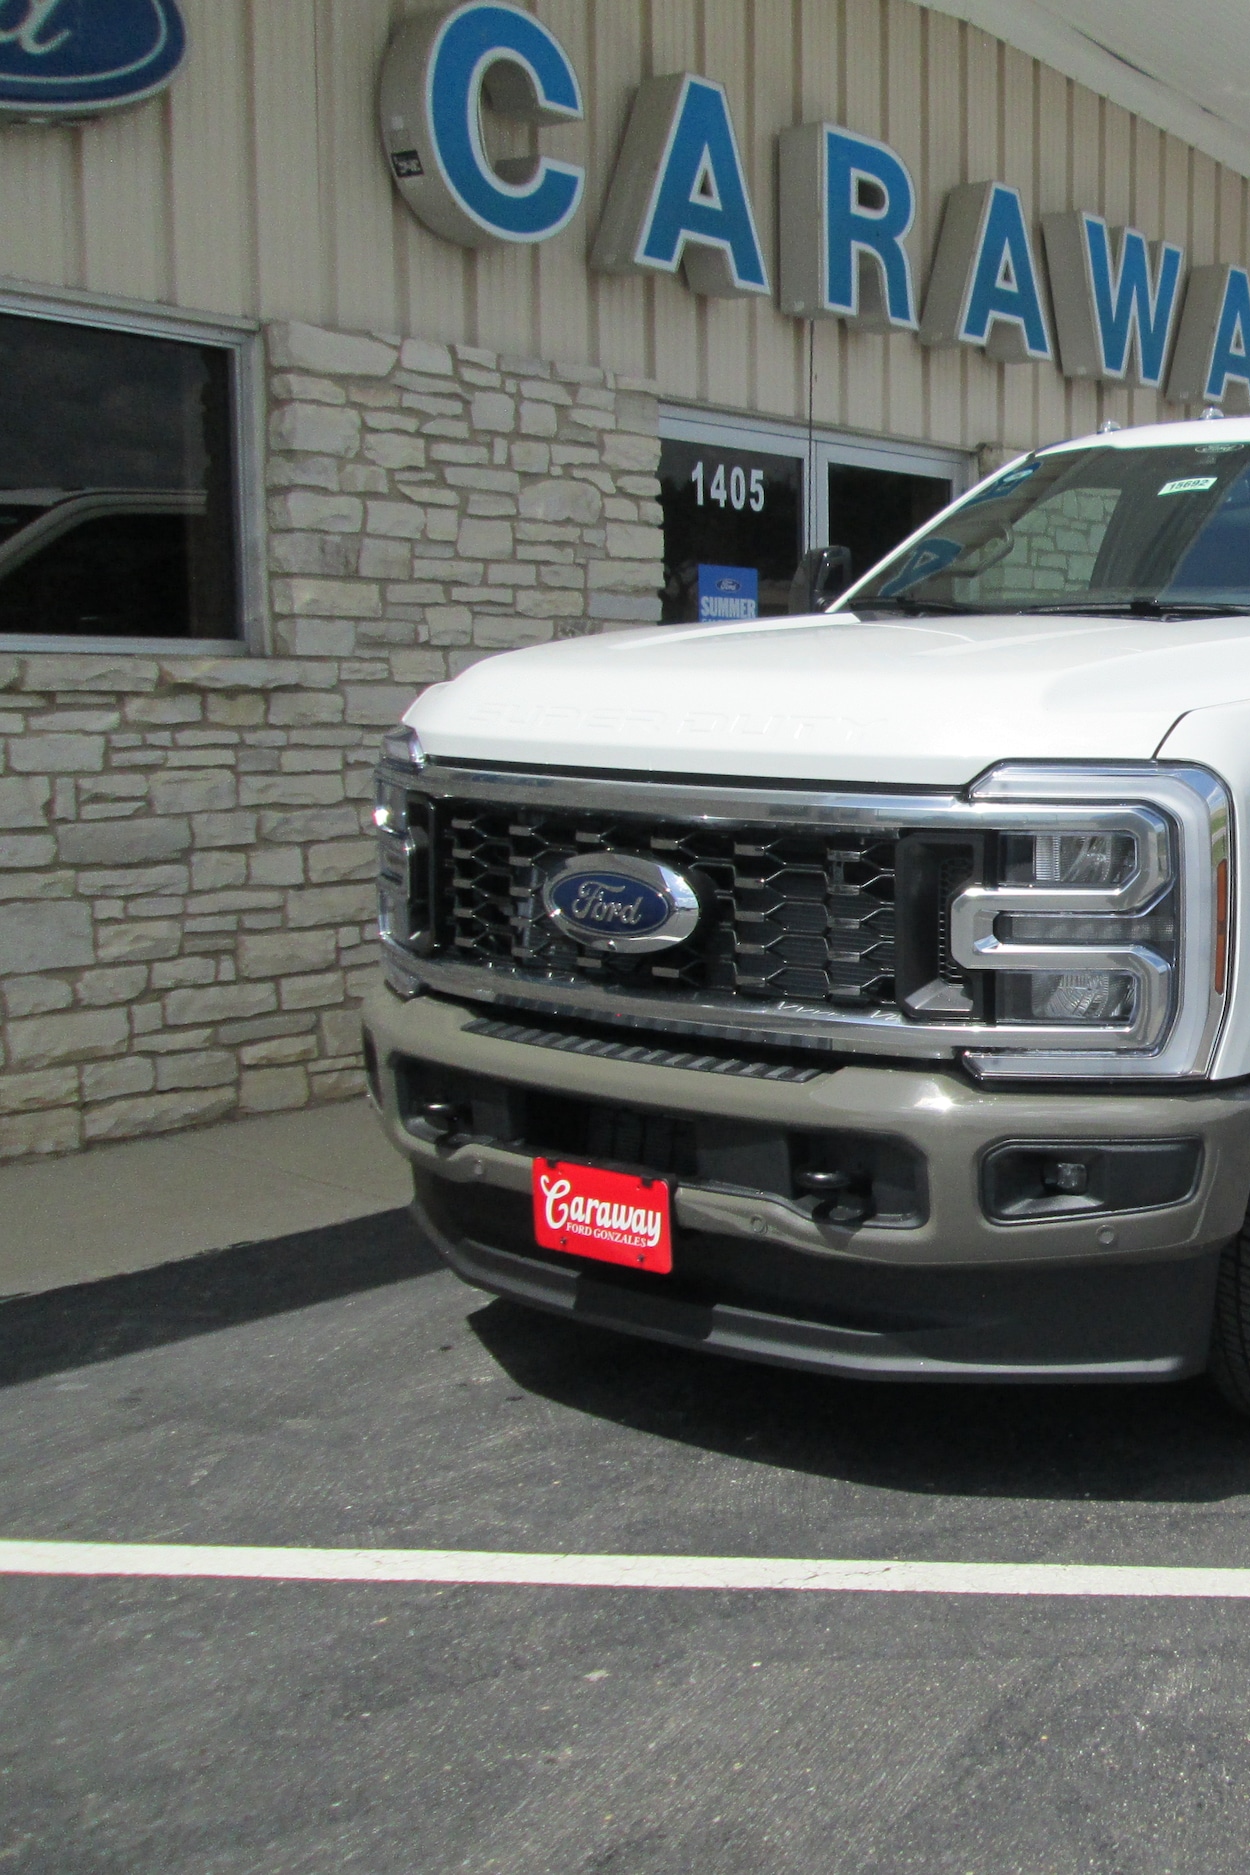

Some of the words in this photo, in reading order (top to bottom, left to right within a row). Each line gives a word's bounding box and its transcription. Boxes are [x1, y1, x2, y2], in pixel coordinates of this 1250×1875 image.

[691, 461, 765, 512] 1405
[701, 596, 756, 618] SUMMER
[468, 702, 668, 733] SUPER
[676, 711, 889, 741] DUTY
[571, 880, 644, 925] Ford
[541, 1175, 661, 1247] Caraway
[566, 1221, 592, 1237] FORD
[593, 1228, 647, 1248] GONZALES
